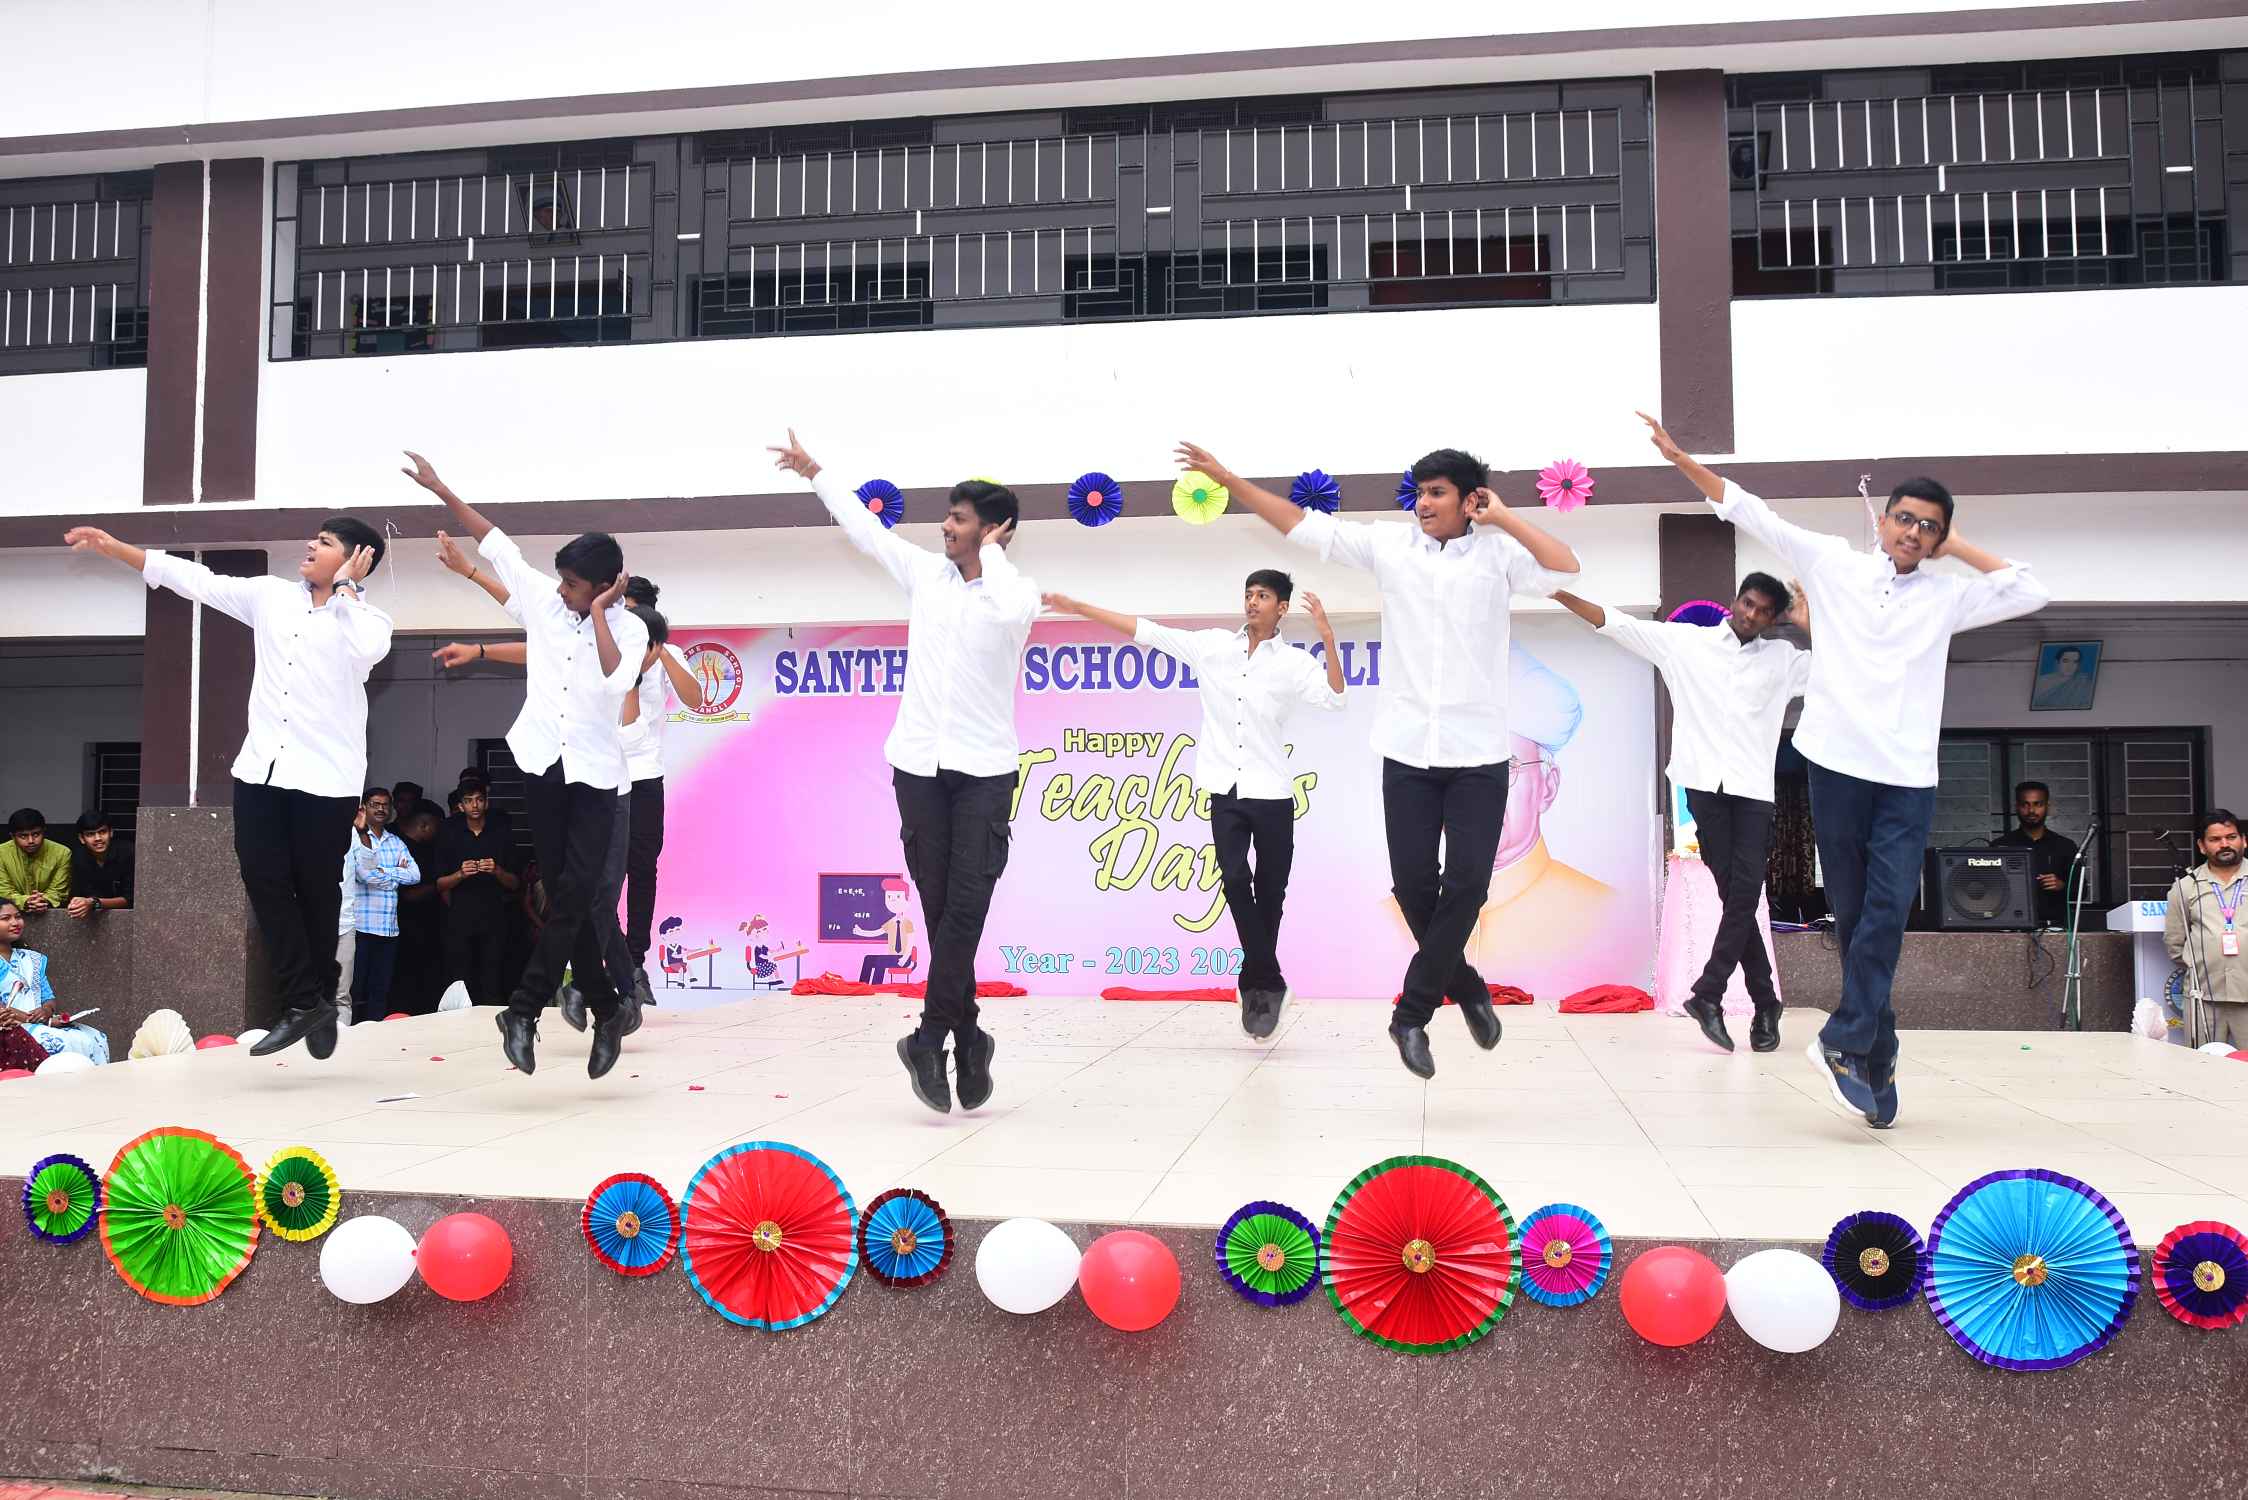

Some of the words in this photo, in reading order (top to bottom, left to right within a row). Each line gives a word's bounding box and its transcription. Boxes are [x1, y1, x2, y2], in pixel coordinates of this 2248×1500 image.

[775, 649, 908, 694] SANTH
[1025, 645, 1200, 690] SCHOOL
[695, 703, 728, 714] ANGLI
[1063, 728, 1164, 758] Happy
[1089, 817, 1229, 933] Day
[1967, 857, 2002, 867] Roland
[999, 945, 1075, 974] Year
[1105, 946, 1181, 976] 2023
[1190, 946, 1245, 976] 202
